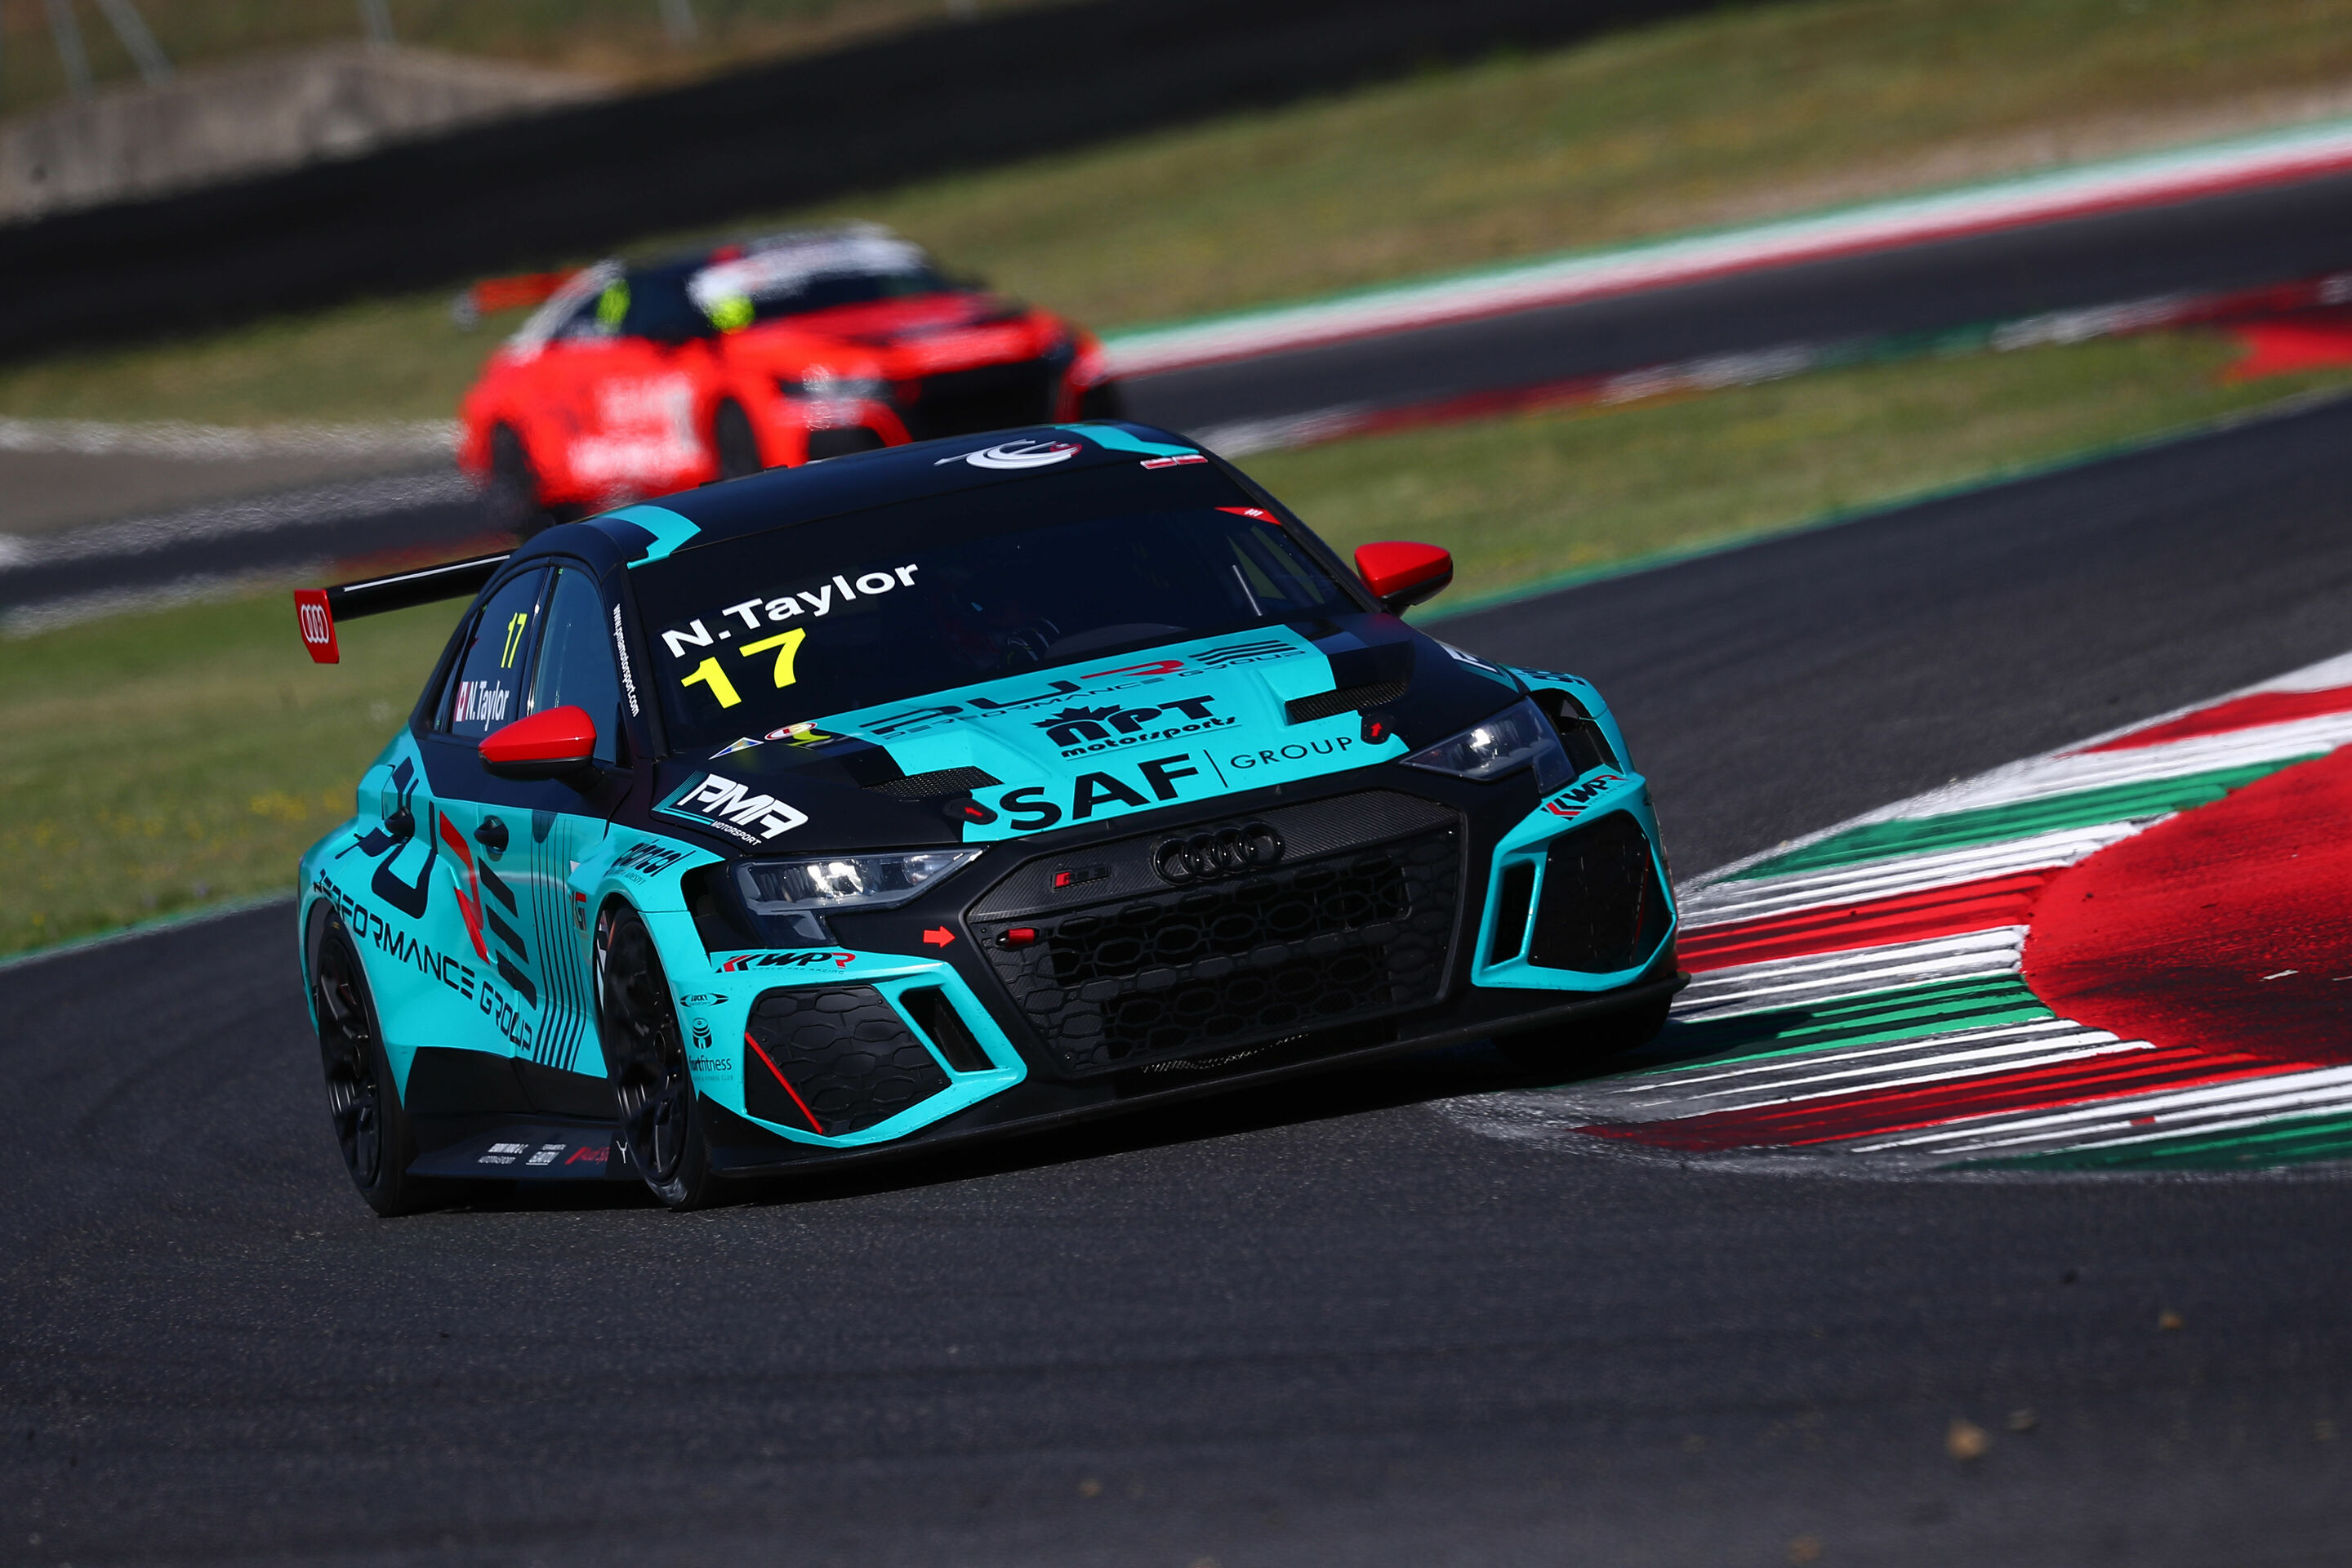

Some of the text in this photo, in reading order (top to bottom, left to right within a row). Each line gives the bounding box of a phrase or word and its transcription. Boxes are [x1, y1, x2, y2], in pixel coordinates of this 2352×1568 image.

[501, 612, 528, 669] 17
[662, 564, 918, 658] N.Taylor
[613, 603, 639, 717] www.pmamotorsport.com
[681, 627, 806, 709] 17
[1178, 650, 1307, 677] GROUP
[466, 679, 510, 732] N.Taylor
[1061, 715, 1236, 758] motorsports
[676, 773, 809, 840] PMA
[999, 736, 1353, 831] SAF GROUP
[710, 820, 762, 846] MOTORSPORT
[479, 981, 533, 1052] GROUP
[690, 994, 709, 1002] LUCKY
